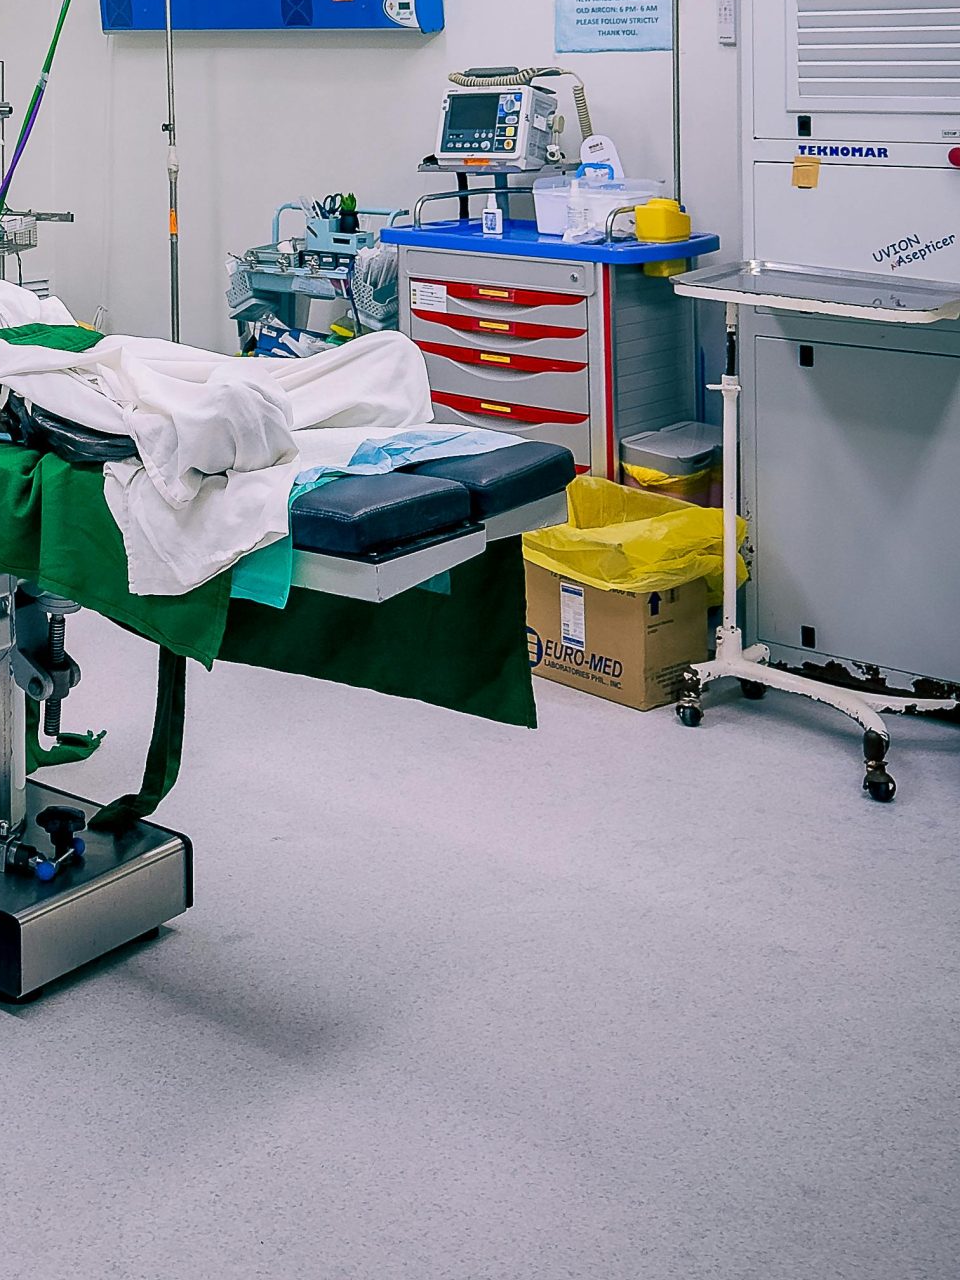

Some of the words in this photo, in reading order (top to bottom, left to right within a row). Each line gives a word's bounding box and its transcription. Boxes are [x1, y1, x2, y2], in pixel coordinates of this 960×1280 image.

[798, 145, 889, 158] TEKNOMAR
[872, 233, 921, 263] UVION
[897, 234, 956, 267] Asepticer
[544, 639, 623, 679] EURO-MED
